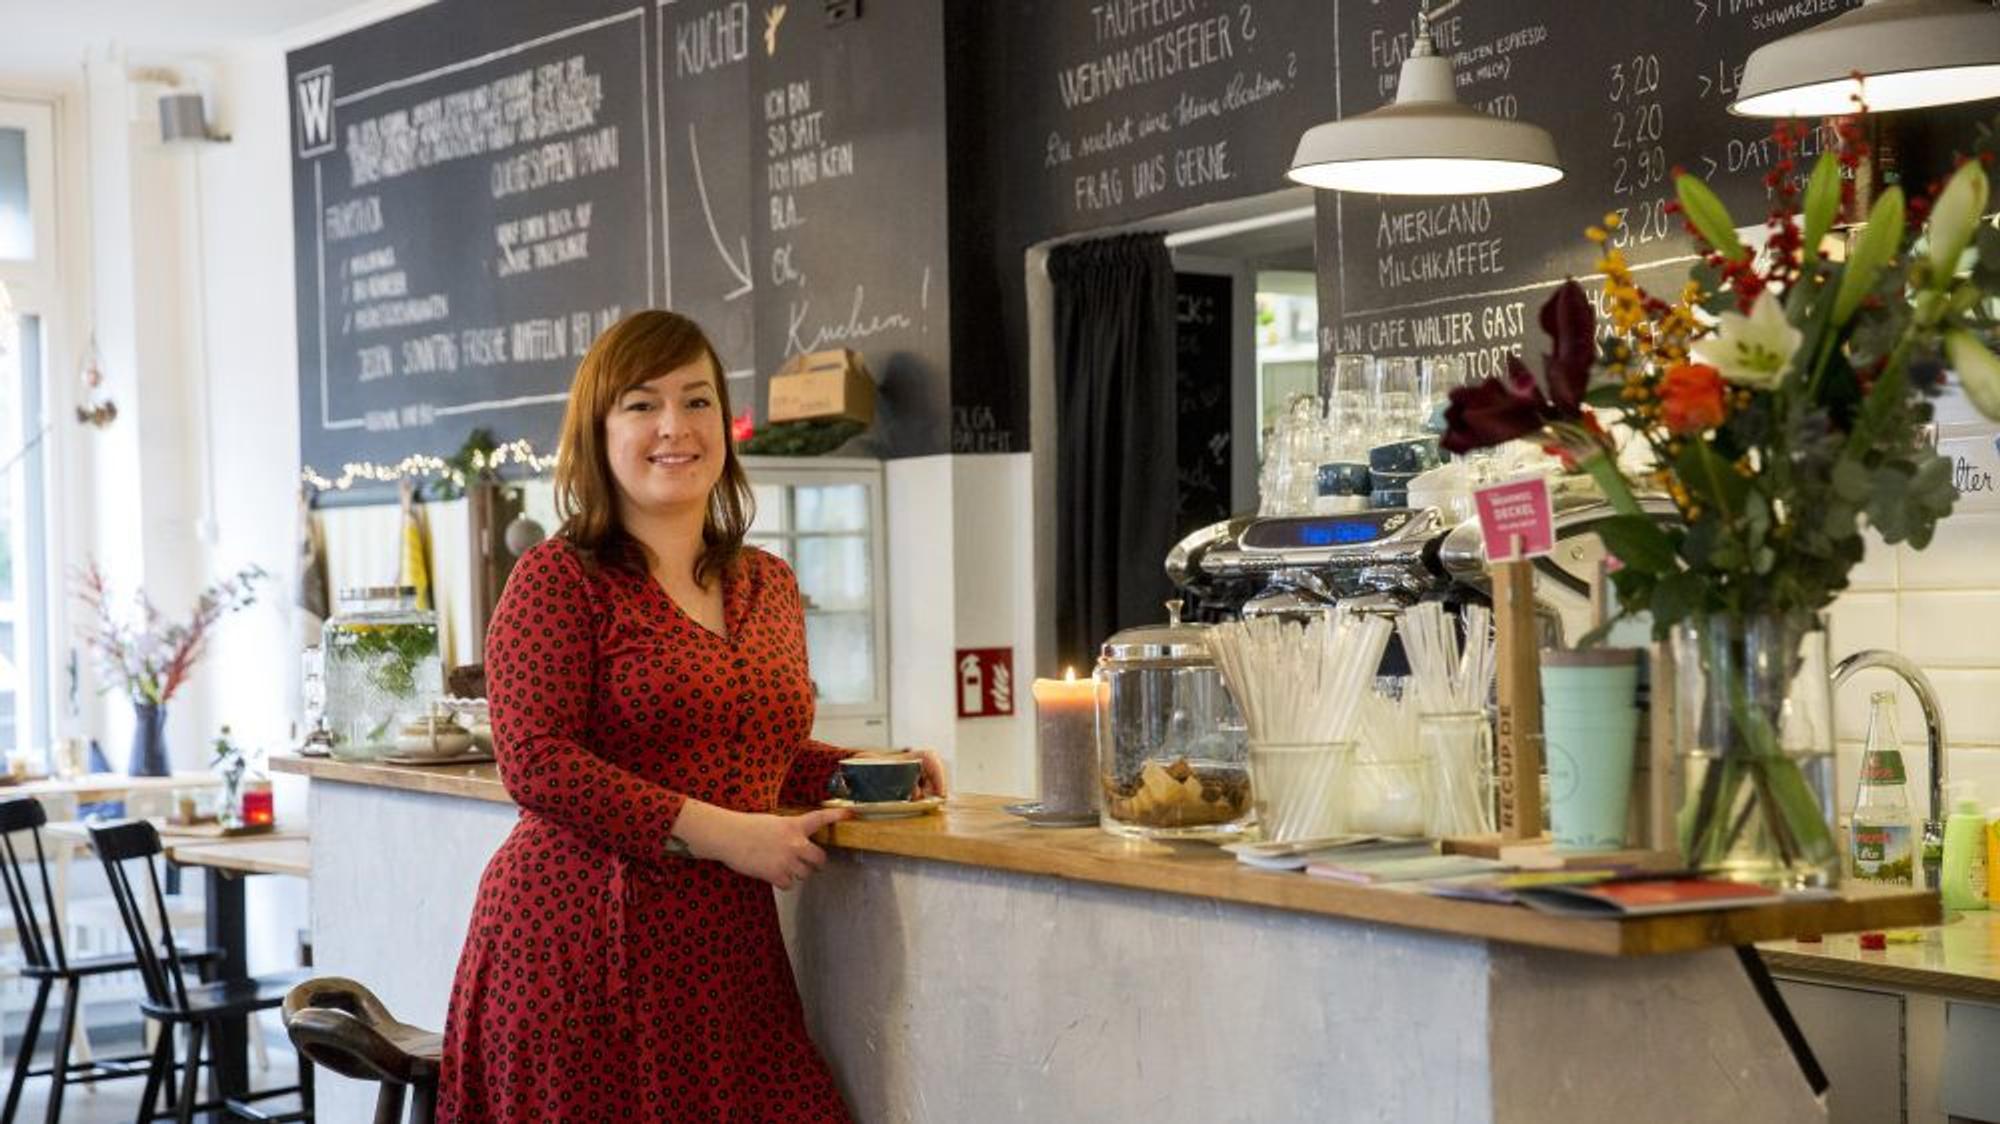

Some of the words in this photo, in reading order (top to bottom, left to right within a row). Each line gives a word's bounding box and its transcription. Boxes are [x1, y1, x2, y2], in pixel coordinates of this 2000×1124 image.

[1411, 14, 1462, 51] HITE
[1609, 54, 1660, 104] 3,20
[1719, 58, 1744, 96] LE
[299, 74, 333, 146] W
[1612, 102, 1664, 150] 2,20
[1613, 145, 1666, 196] 2,90
[1376, 196, 1492, 250] AMERICANO
[1613, 198, 1668, 249] 3,20
[1379, 238, 1505, 289] MILCHKAFFEE
[1369, 319, 1410, 352] CAFE
[1411, 311, 1476, 347] WALTER
[1481, 302, 1526, 340] GAST
[1952, 456, 1994, 493] lter
